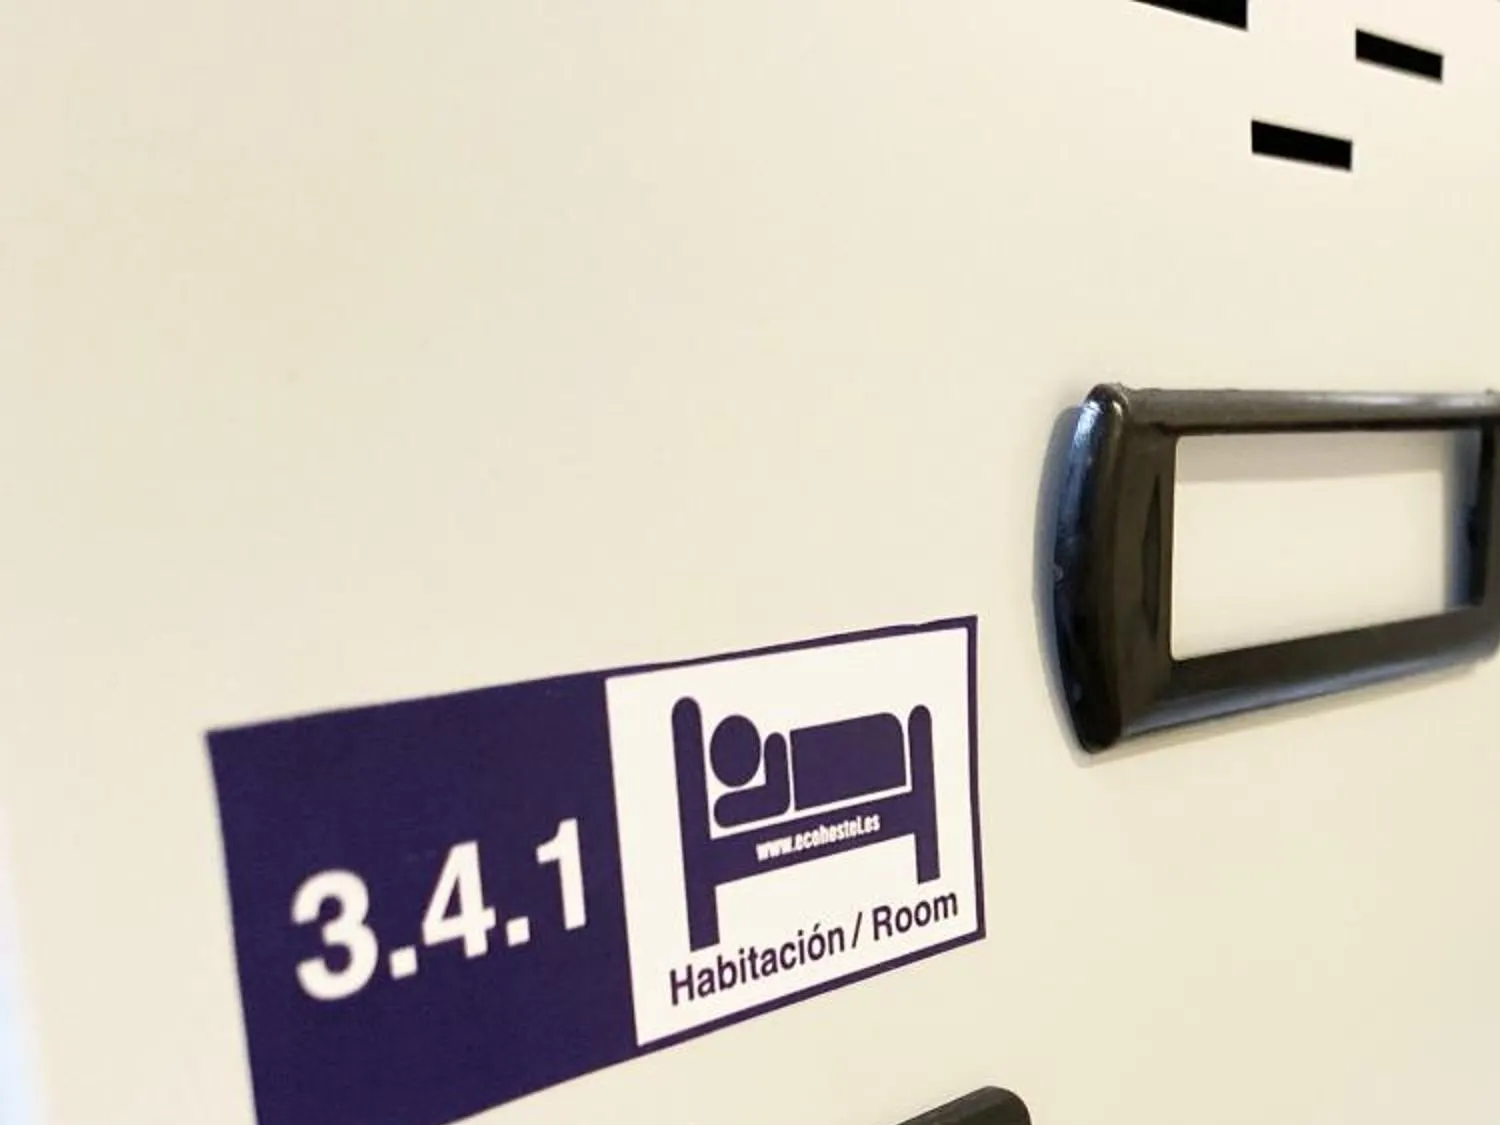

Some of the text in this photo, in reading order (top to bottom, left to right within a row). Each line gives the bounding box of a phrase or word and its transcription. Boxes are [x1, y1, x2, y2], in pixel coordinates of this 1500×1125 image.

[756, 813, 881, 862] www.ecohostel.es
[292, 818, 587, 1000] 3.4.1
[669, 922, 845, 1006] Habitación
[872, 892, 958, 941] Room
